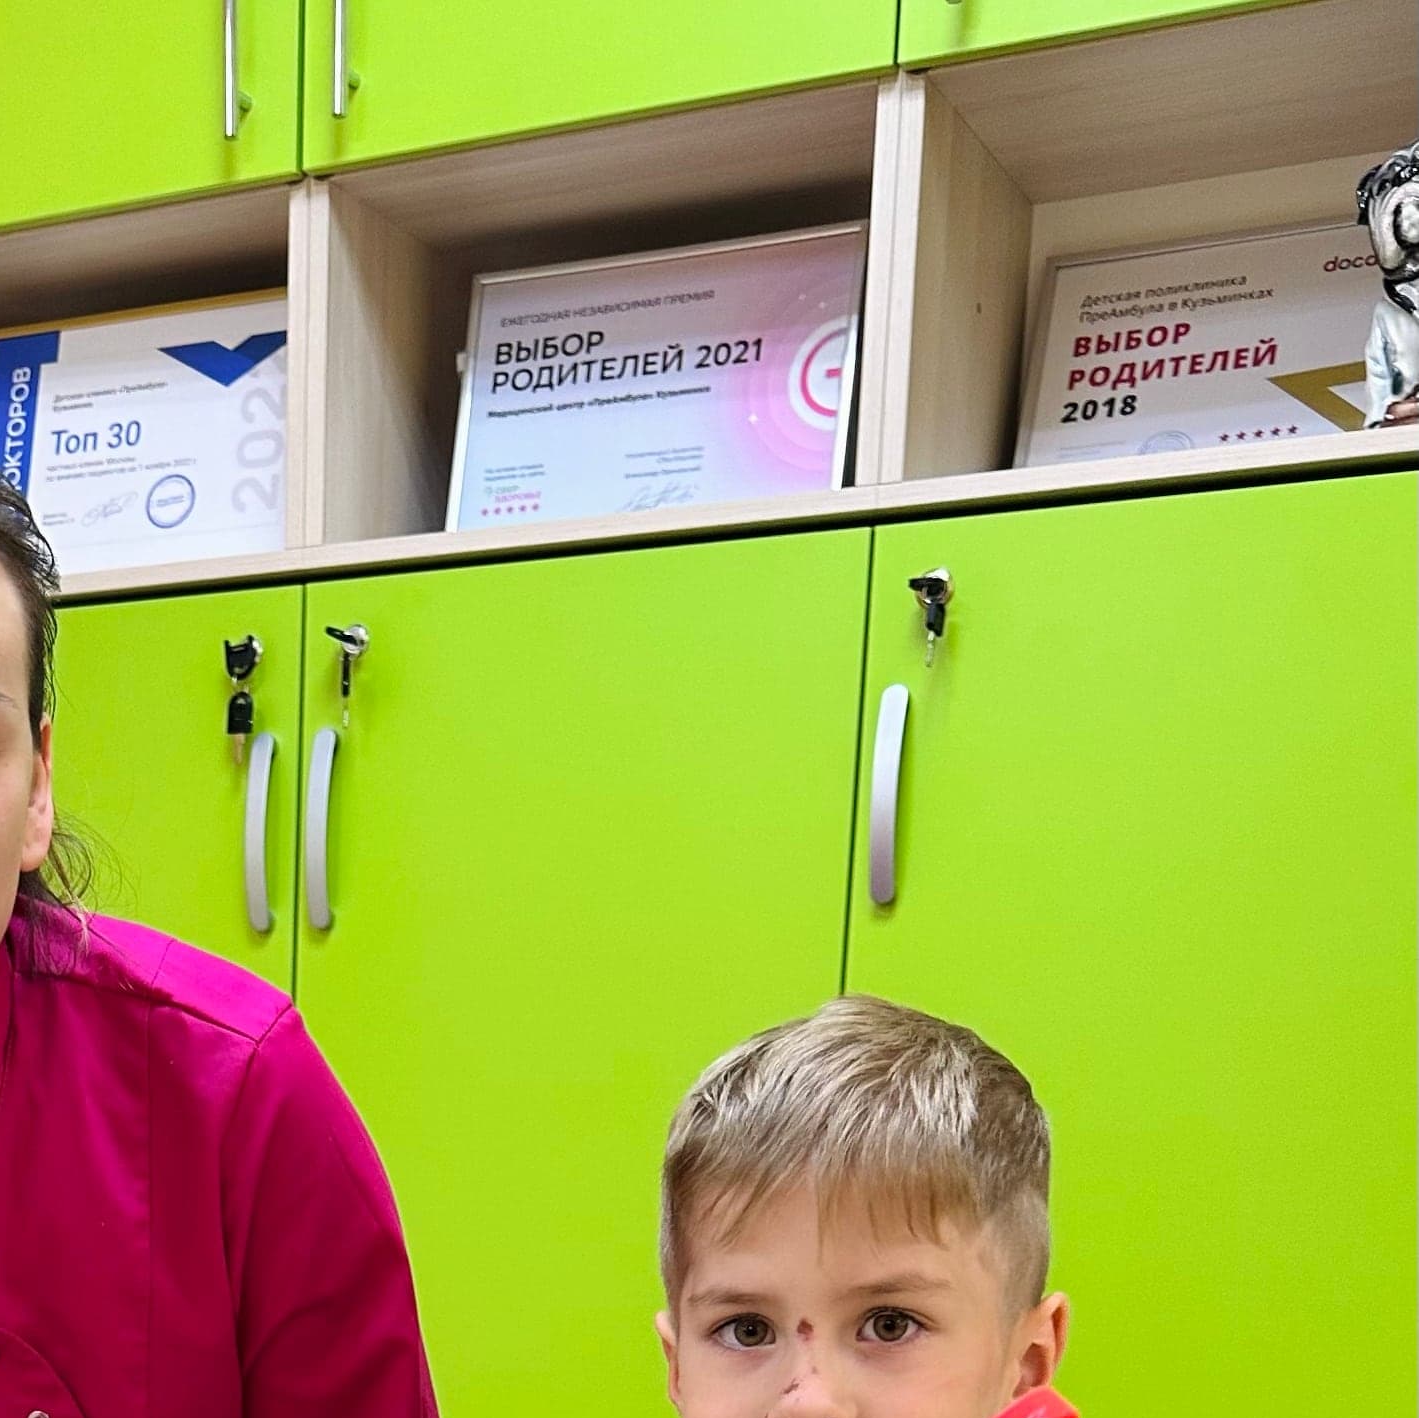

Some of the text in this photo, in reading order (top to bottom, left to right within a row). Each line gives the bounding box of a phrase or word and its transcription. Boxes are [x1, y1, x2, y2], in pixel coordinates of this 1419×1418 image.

[494, 331, 605, 366] ВЫБОР
[1072, 322, 1191, 358] ВЫБОР
[491, 337, 764, 394] РОДИТЕЛЕЙ 2021
[1067, 338, 1279, 391] РОДИТЕЛЕЙ
[3, 366, 32, 491] ОКТОРОВ
[1061, 395, 1137, 424] 2018
[51, 420, 141, 455] Топ 30
[232, 352, 286, 513] 202
